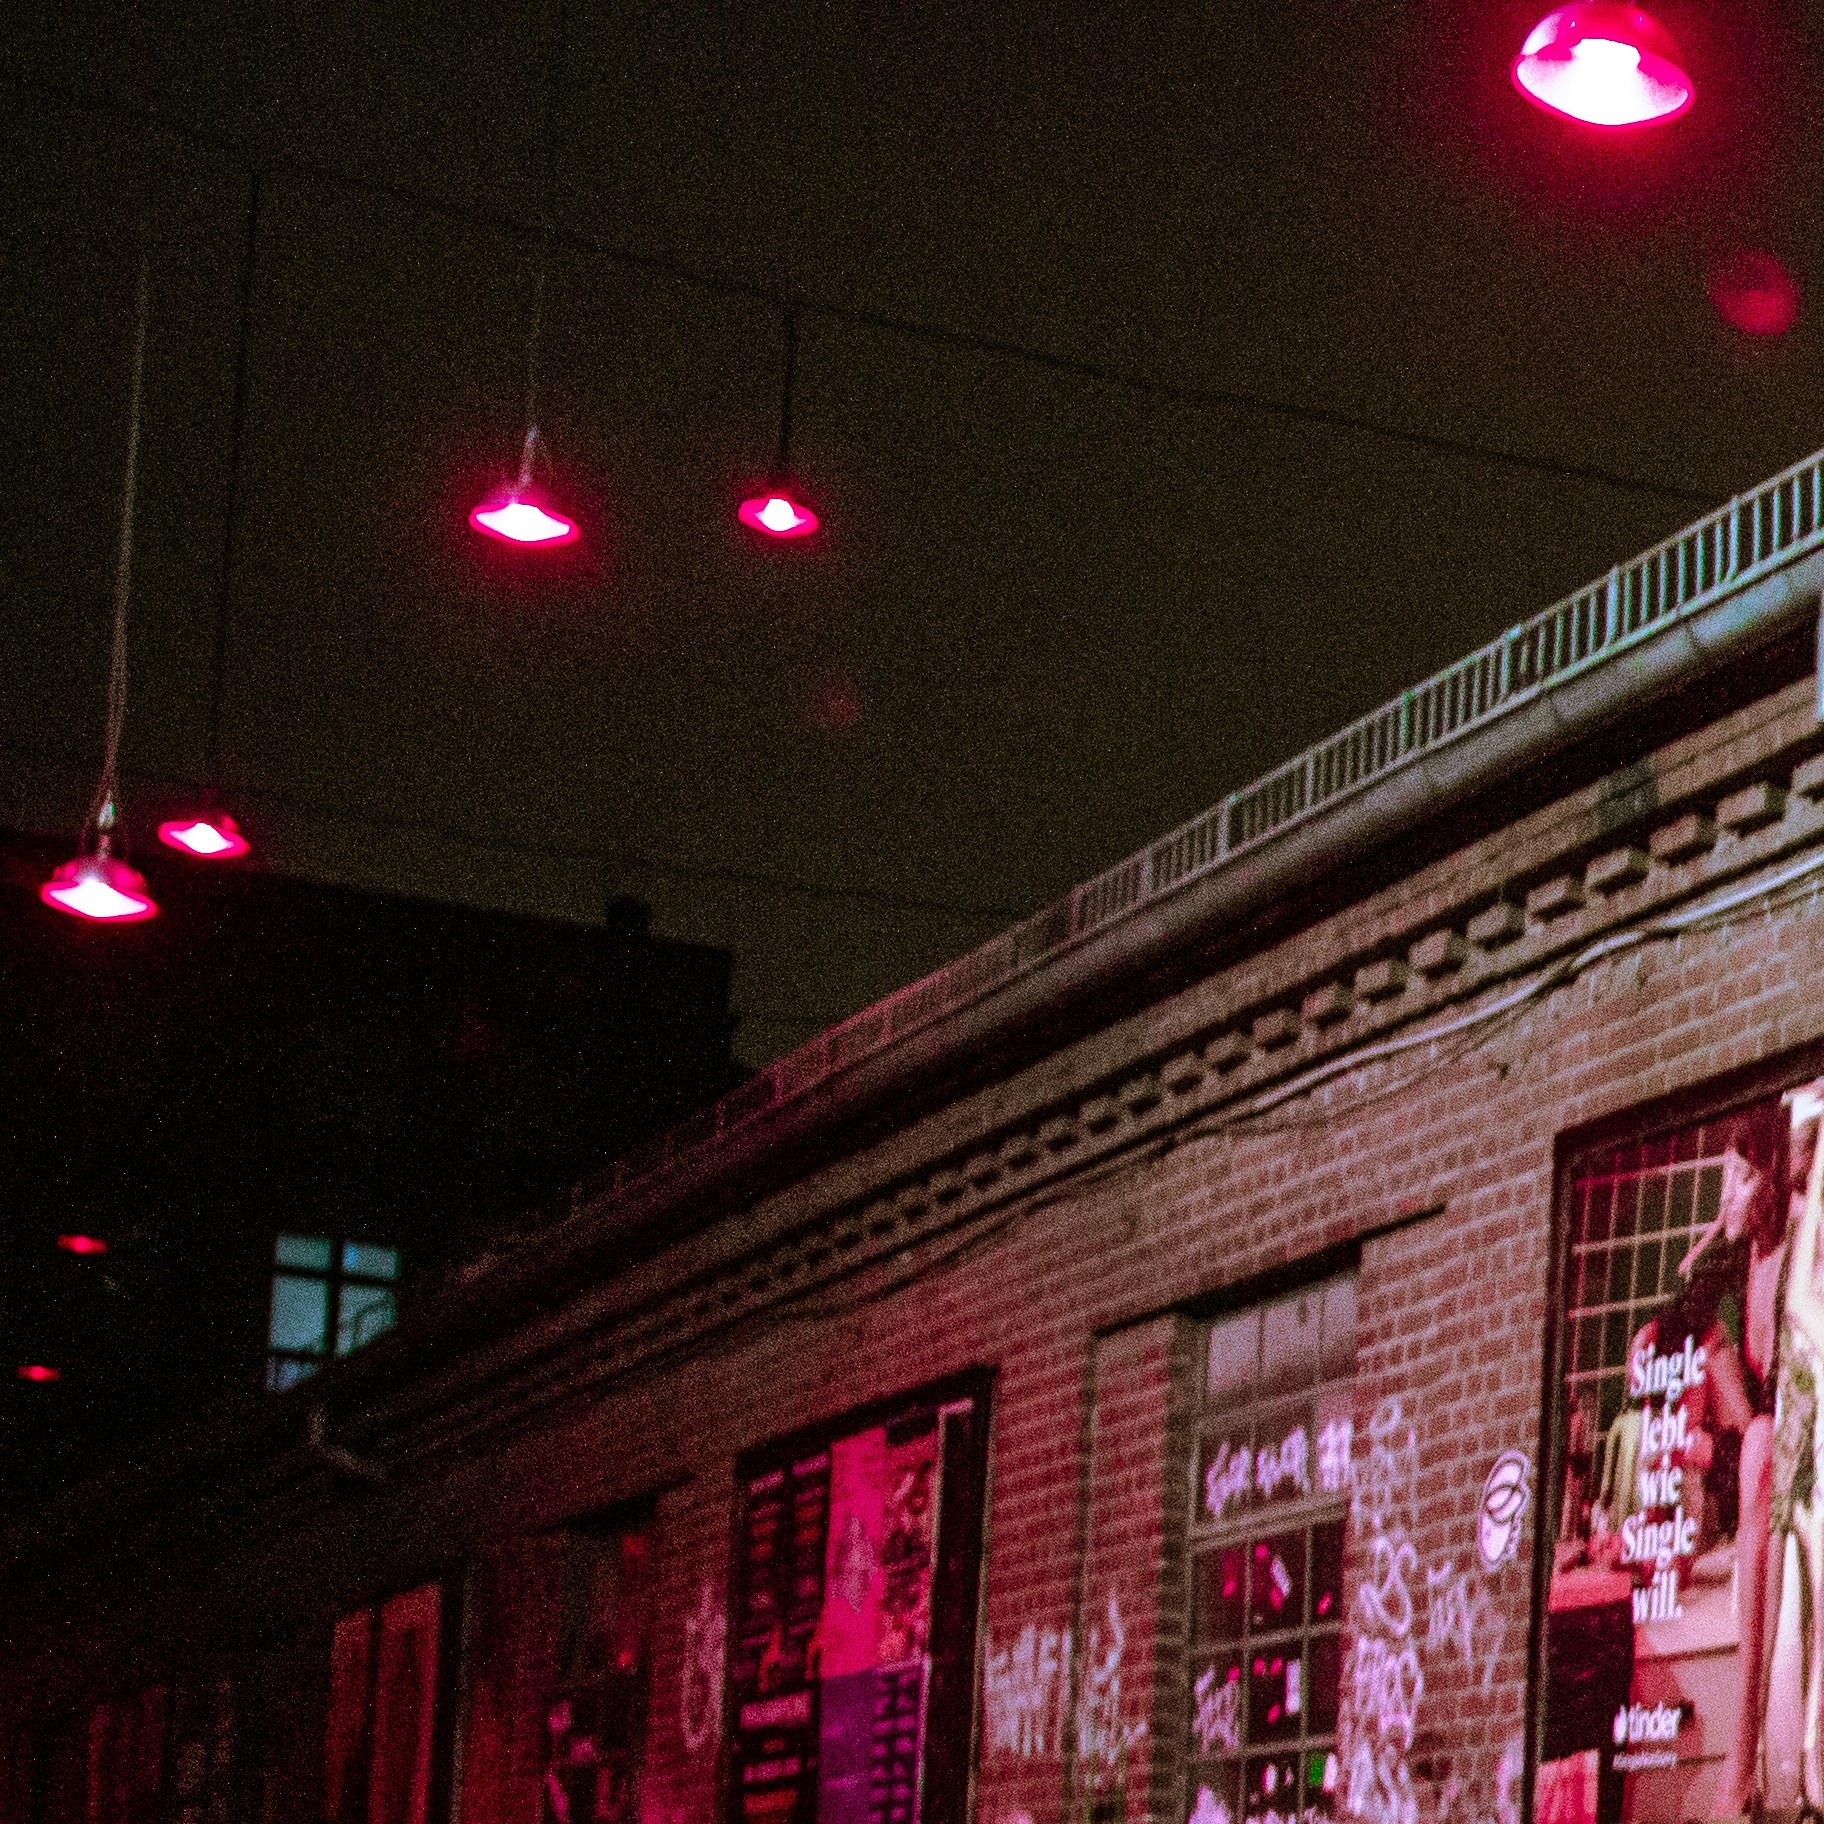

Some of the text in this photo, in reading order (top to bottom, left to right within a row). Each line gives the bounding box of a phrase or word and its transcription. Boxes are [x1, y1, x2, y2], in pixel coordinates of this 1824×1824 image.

[1631, 1336, 1707, 1401] Single
[1640, 1405, 1693, 1457] lebt,
[1639, 1462, 1681, 1508] wie
[1622, 1512, 1697, 1573] Single
[1632, 1575, 1683, 1624] will.
[1627, 1702, 1682, 1743] tinder
